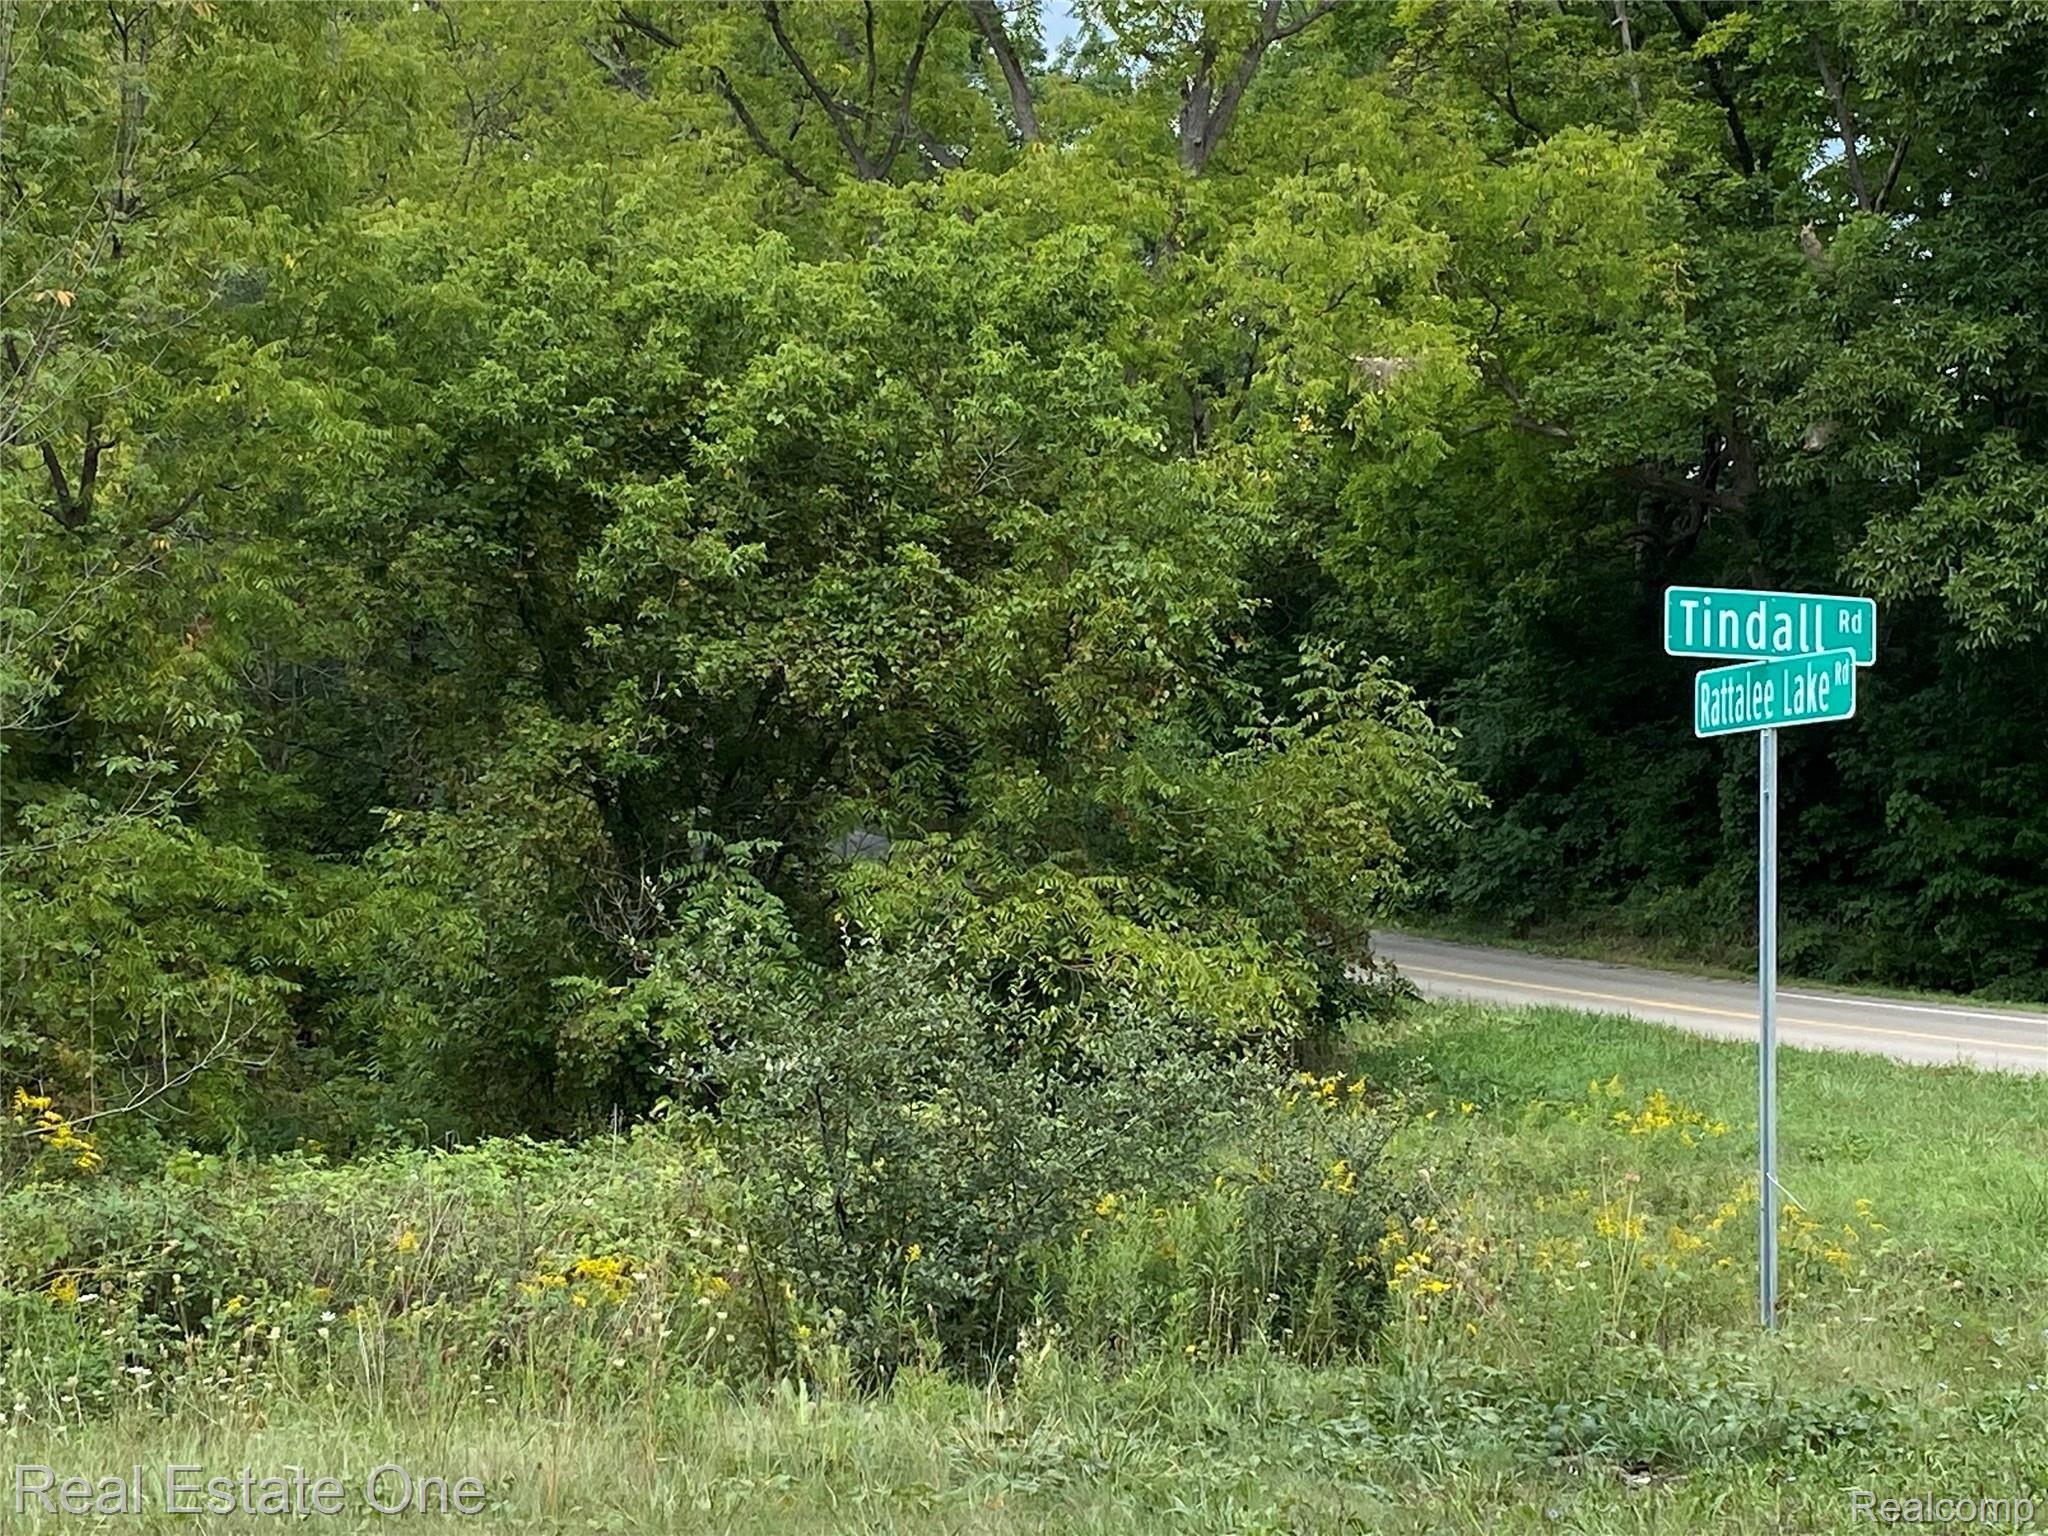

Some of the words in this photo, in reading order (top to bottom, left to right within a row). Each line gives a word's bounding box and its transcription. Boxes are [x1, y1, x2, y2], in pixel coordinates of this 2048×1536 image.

[1680, 596, 1825, 653] Tindall
[1839, 609, 1862, 634] Rd
[1700, 671, 1775, 728] Rattalee
[1783, 661, 1830, 716] Lake
[1834, 658, 1849, 686] Rd
